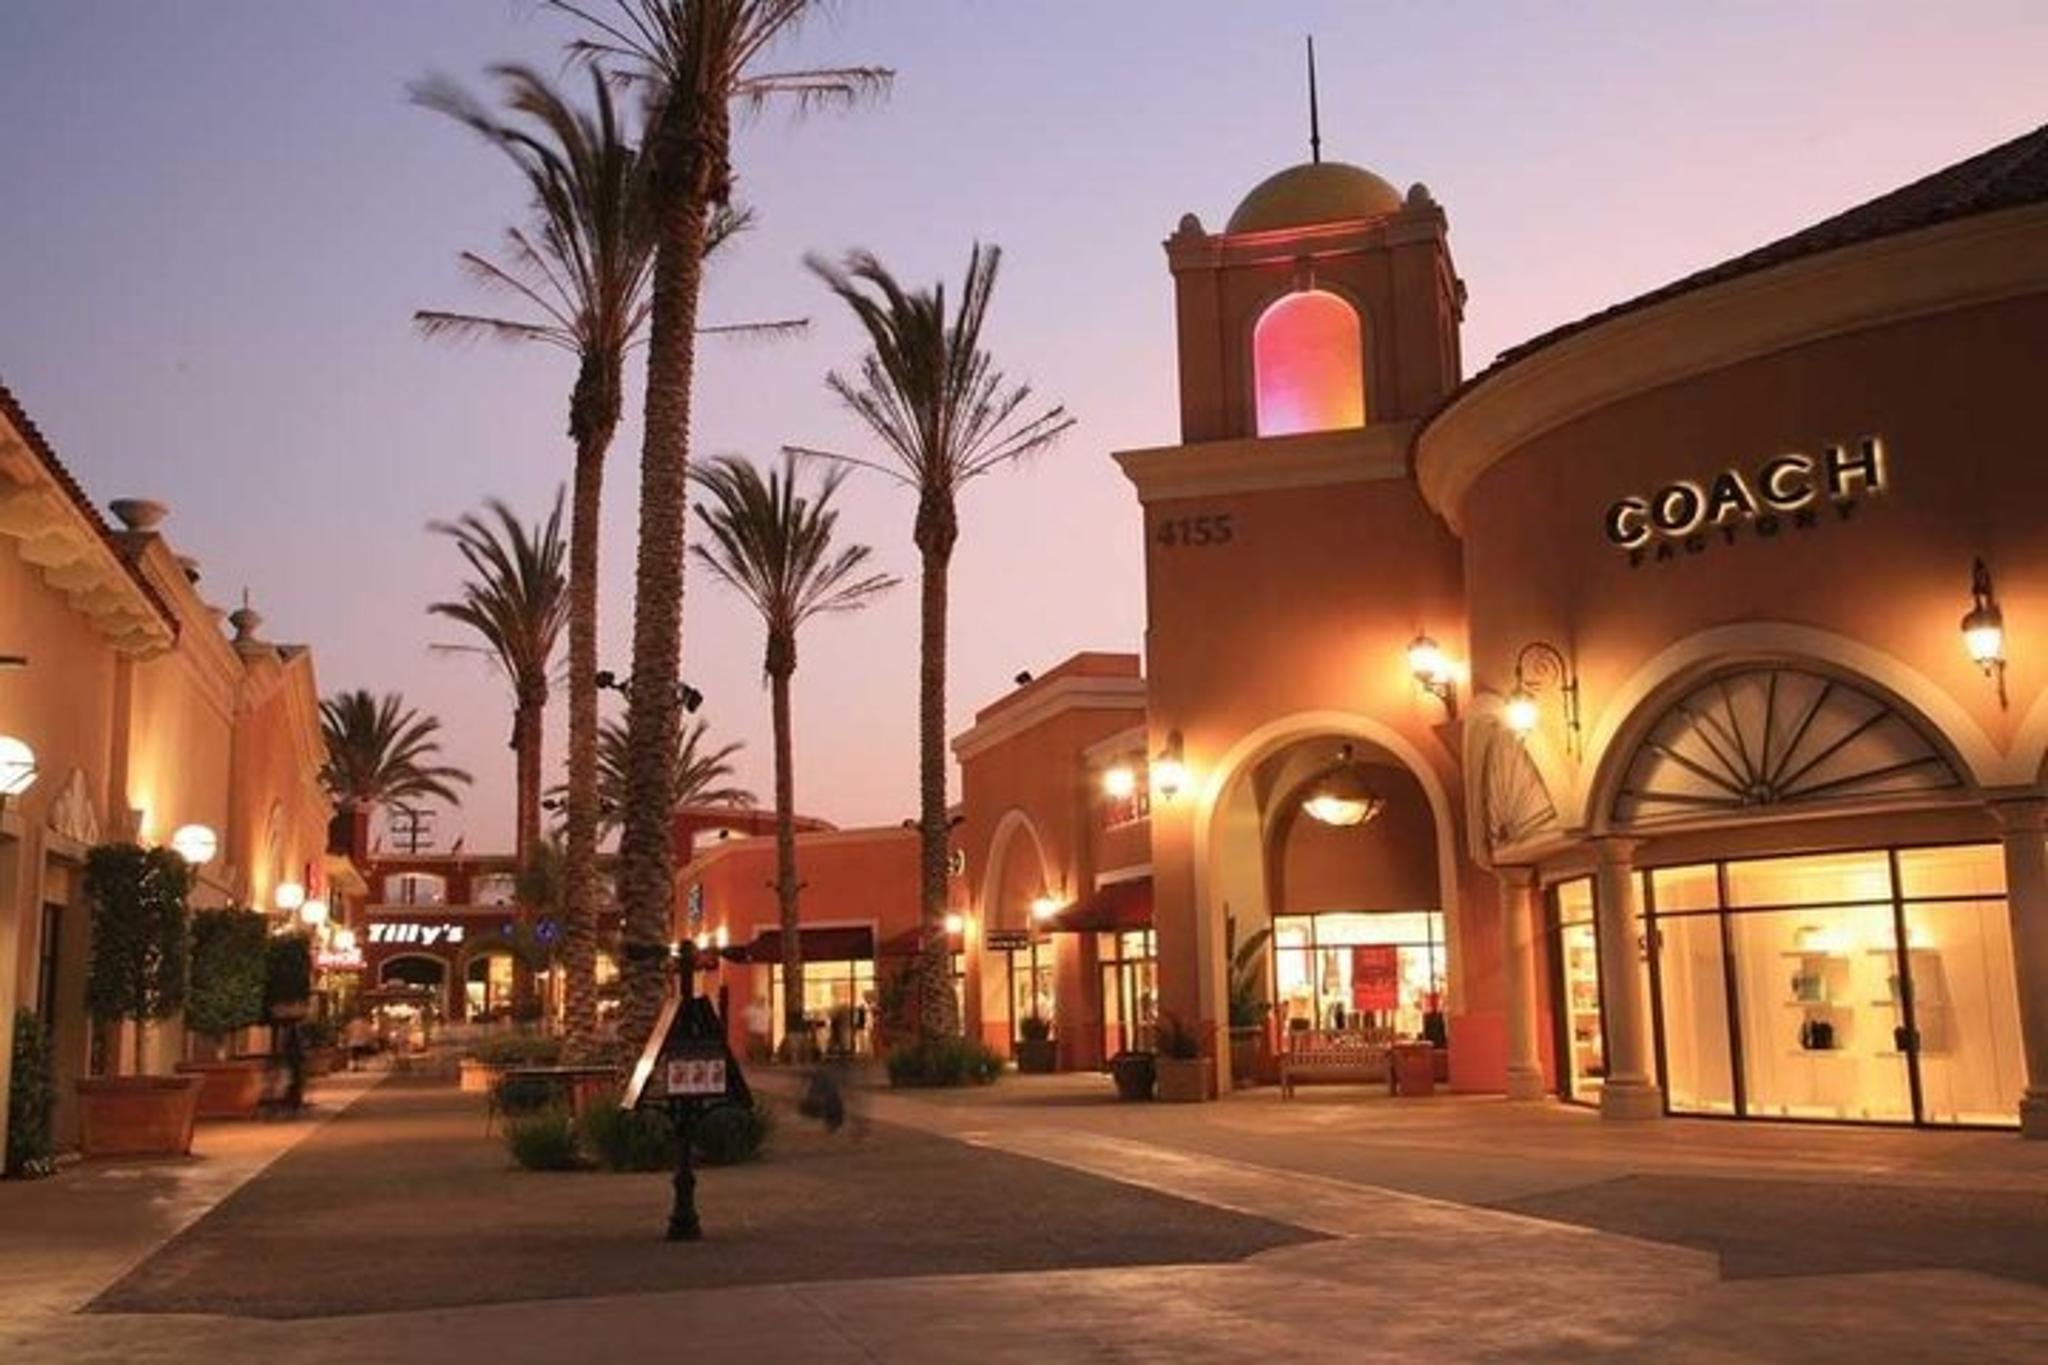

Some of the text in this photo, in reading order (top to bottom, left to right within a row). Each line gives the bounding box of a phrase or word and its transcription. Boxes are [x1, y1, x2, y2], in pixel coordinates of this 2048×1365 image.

[1604, 436, 1887, 548] COACH
[1156, 513, 1234, 546] 4155
[1628, 499, 1857, 568] FACTORY
[367, 922, 465, 946] Tilly's
